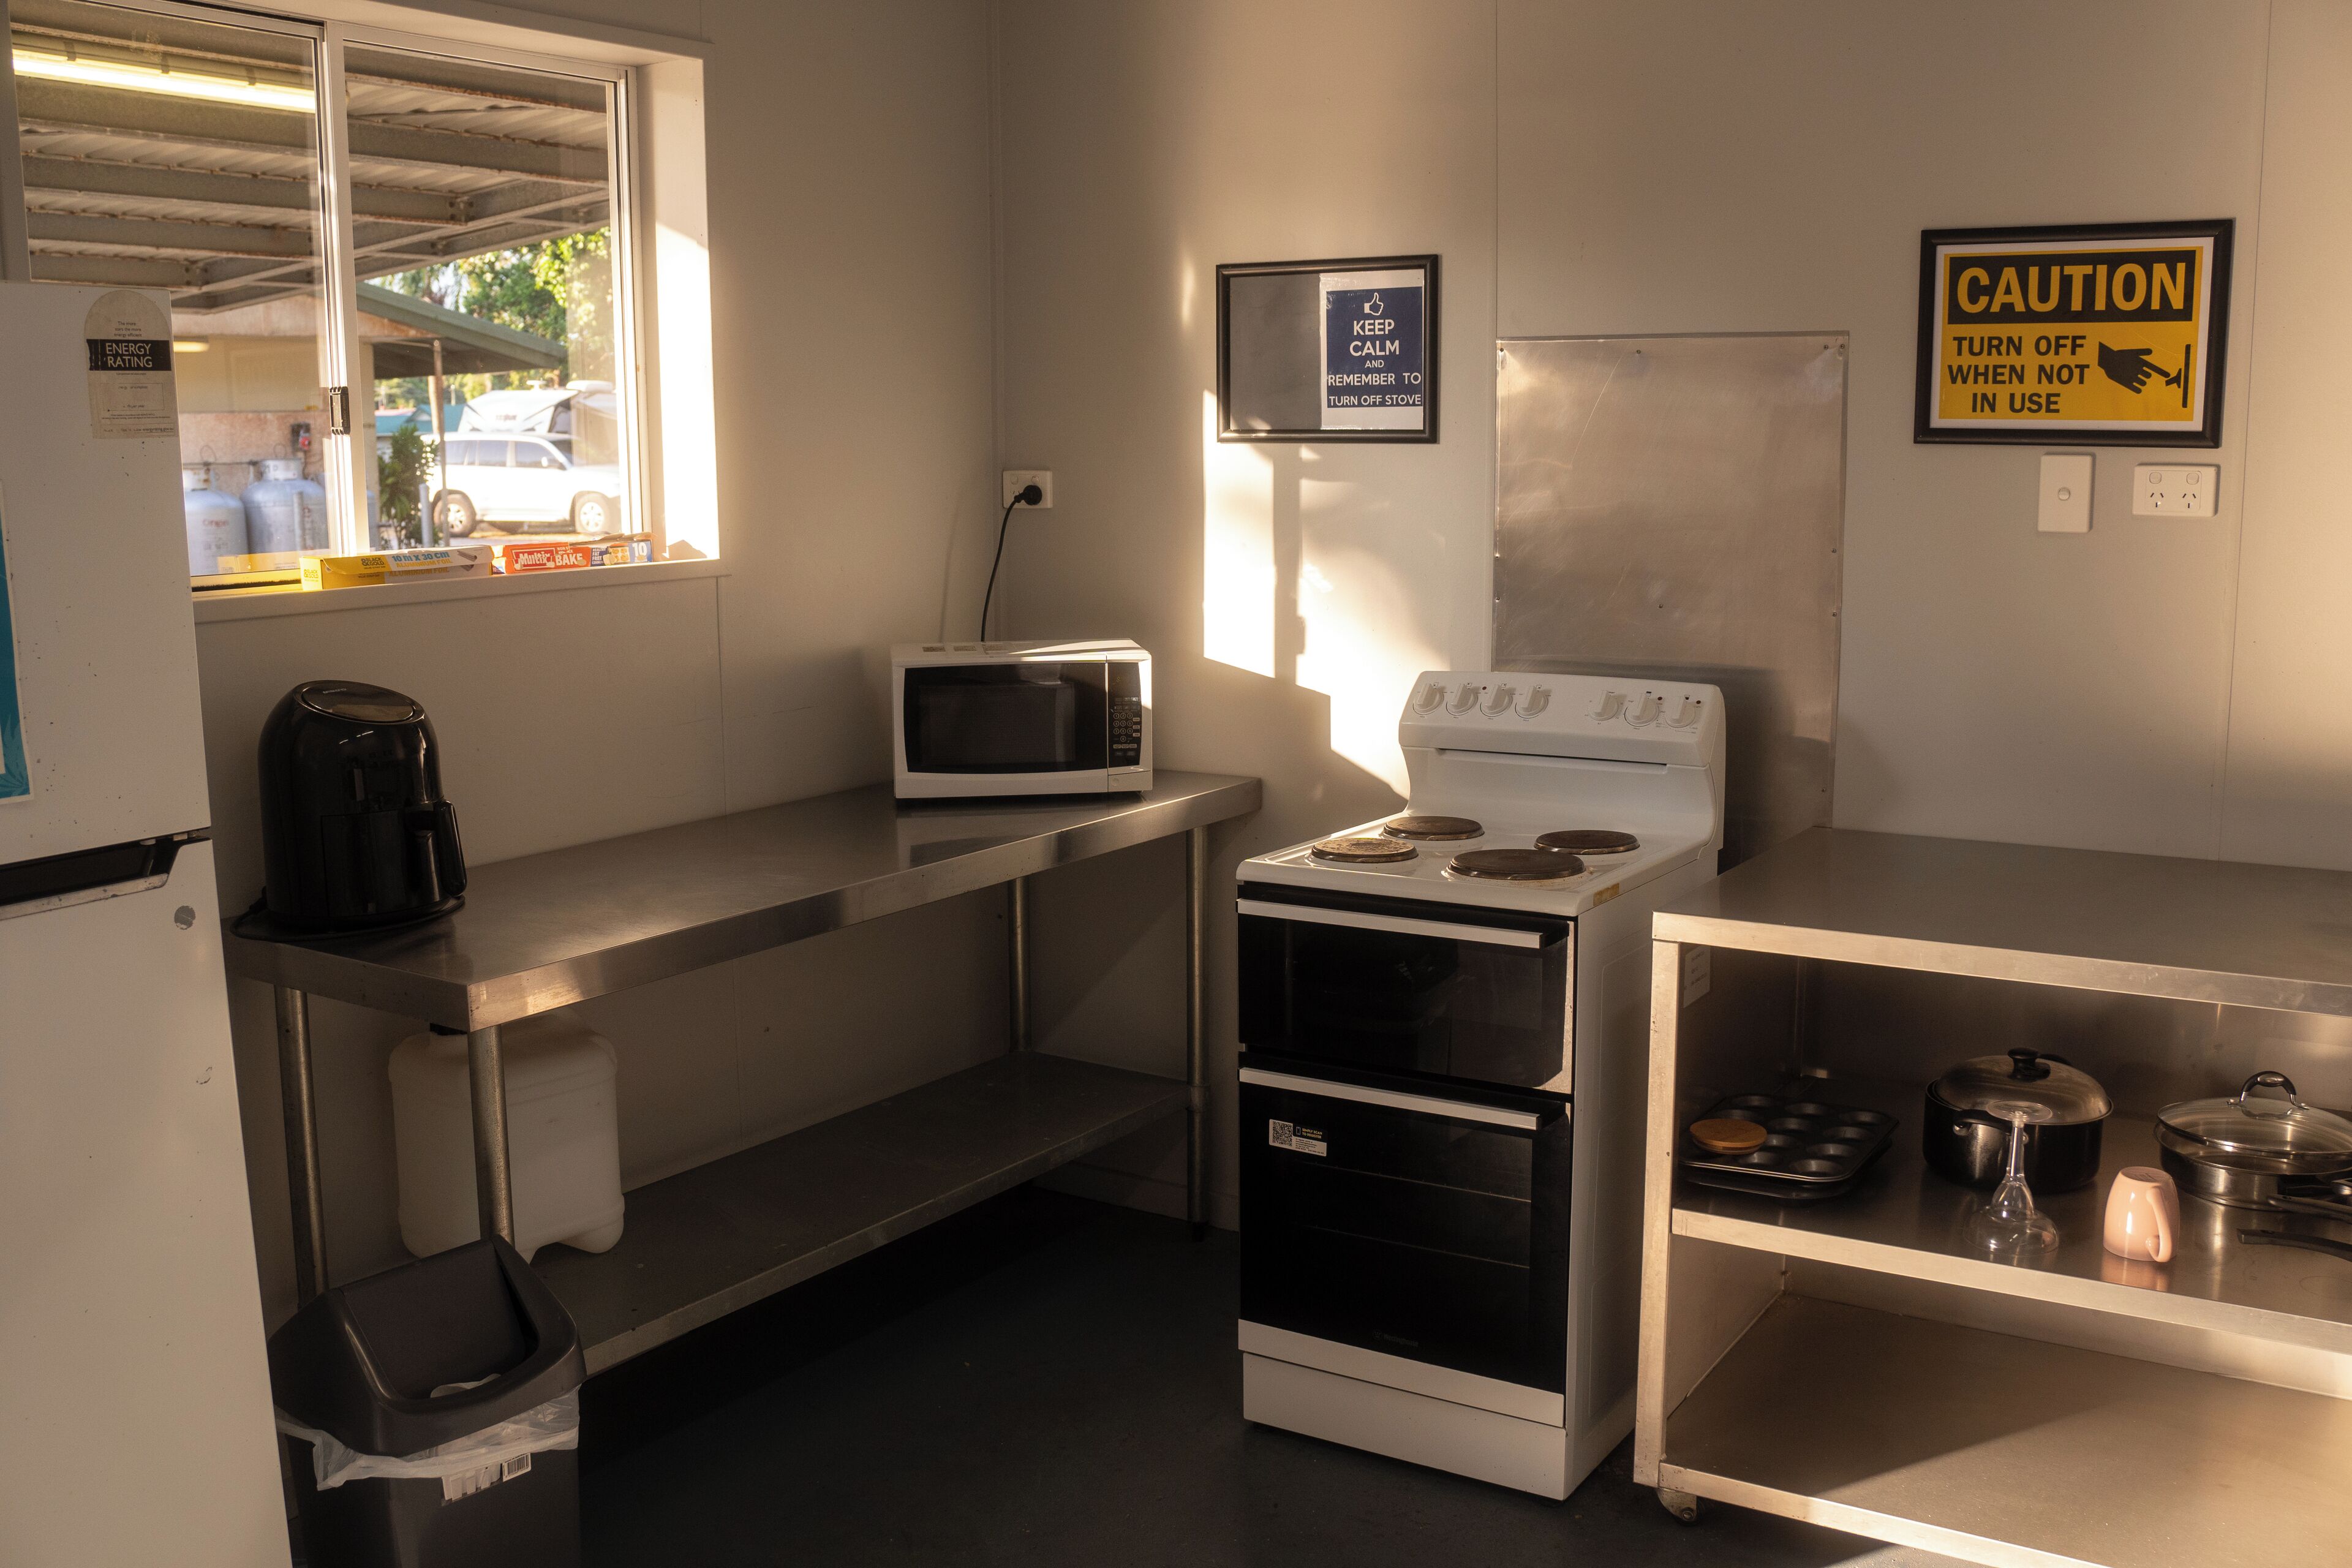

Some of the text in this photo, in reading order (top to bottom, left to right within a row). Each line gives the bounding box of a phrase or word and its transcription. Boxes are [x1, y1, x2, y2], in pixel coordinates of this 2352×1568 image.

[1957, 262, 2186, 314] CAUTION
[1353, 318, 1395, 336] KEEP
[105, 342, 152, 355] ENERGY
[1349, 339, 1400, 356] CALM
[1952, 335, 2087, 356] TURN OFF
[107, 356, 153, 368] RATING
[1365, 360, 1384, 368] AND
[1328, 372, 1421, 386] REMEMBER TO
[1948, 364, 2090, 385] WHEN NOT
[1329, 394, 1421, 406] TURN OFF STOVE
[1971, 392, 2060, 413] IN USE
[631, 542, 647, 557] 10
